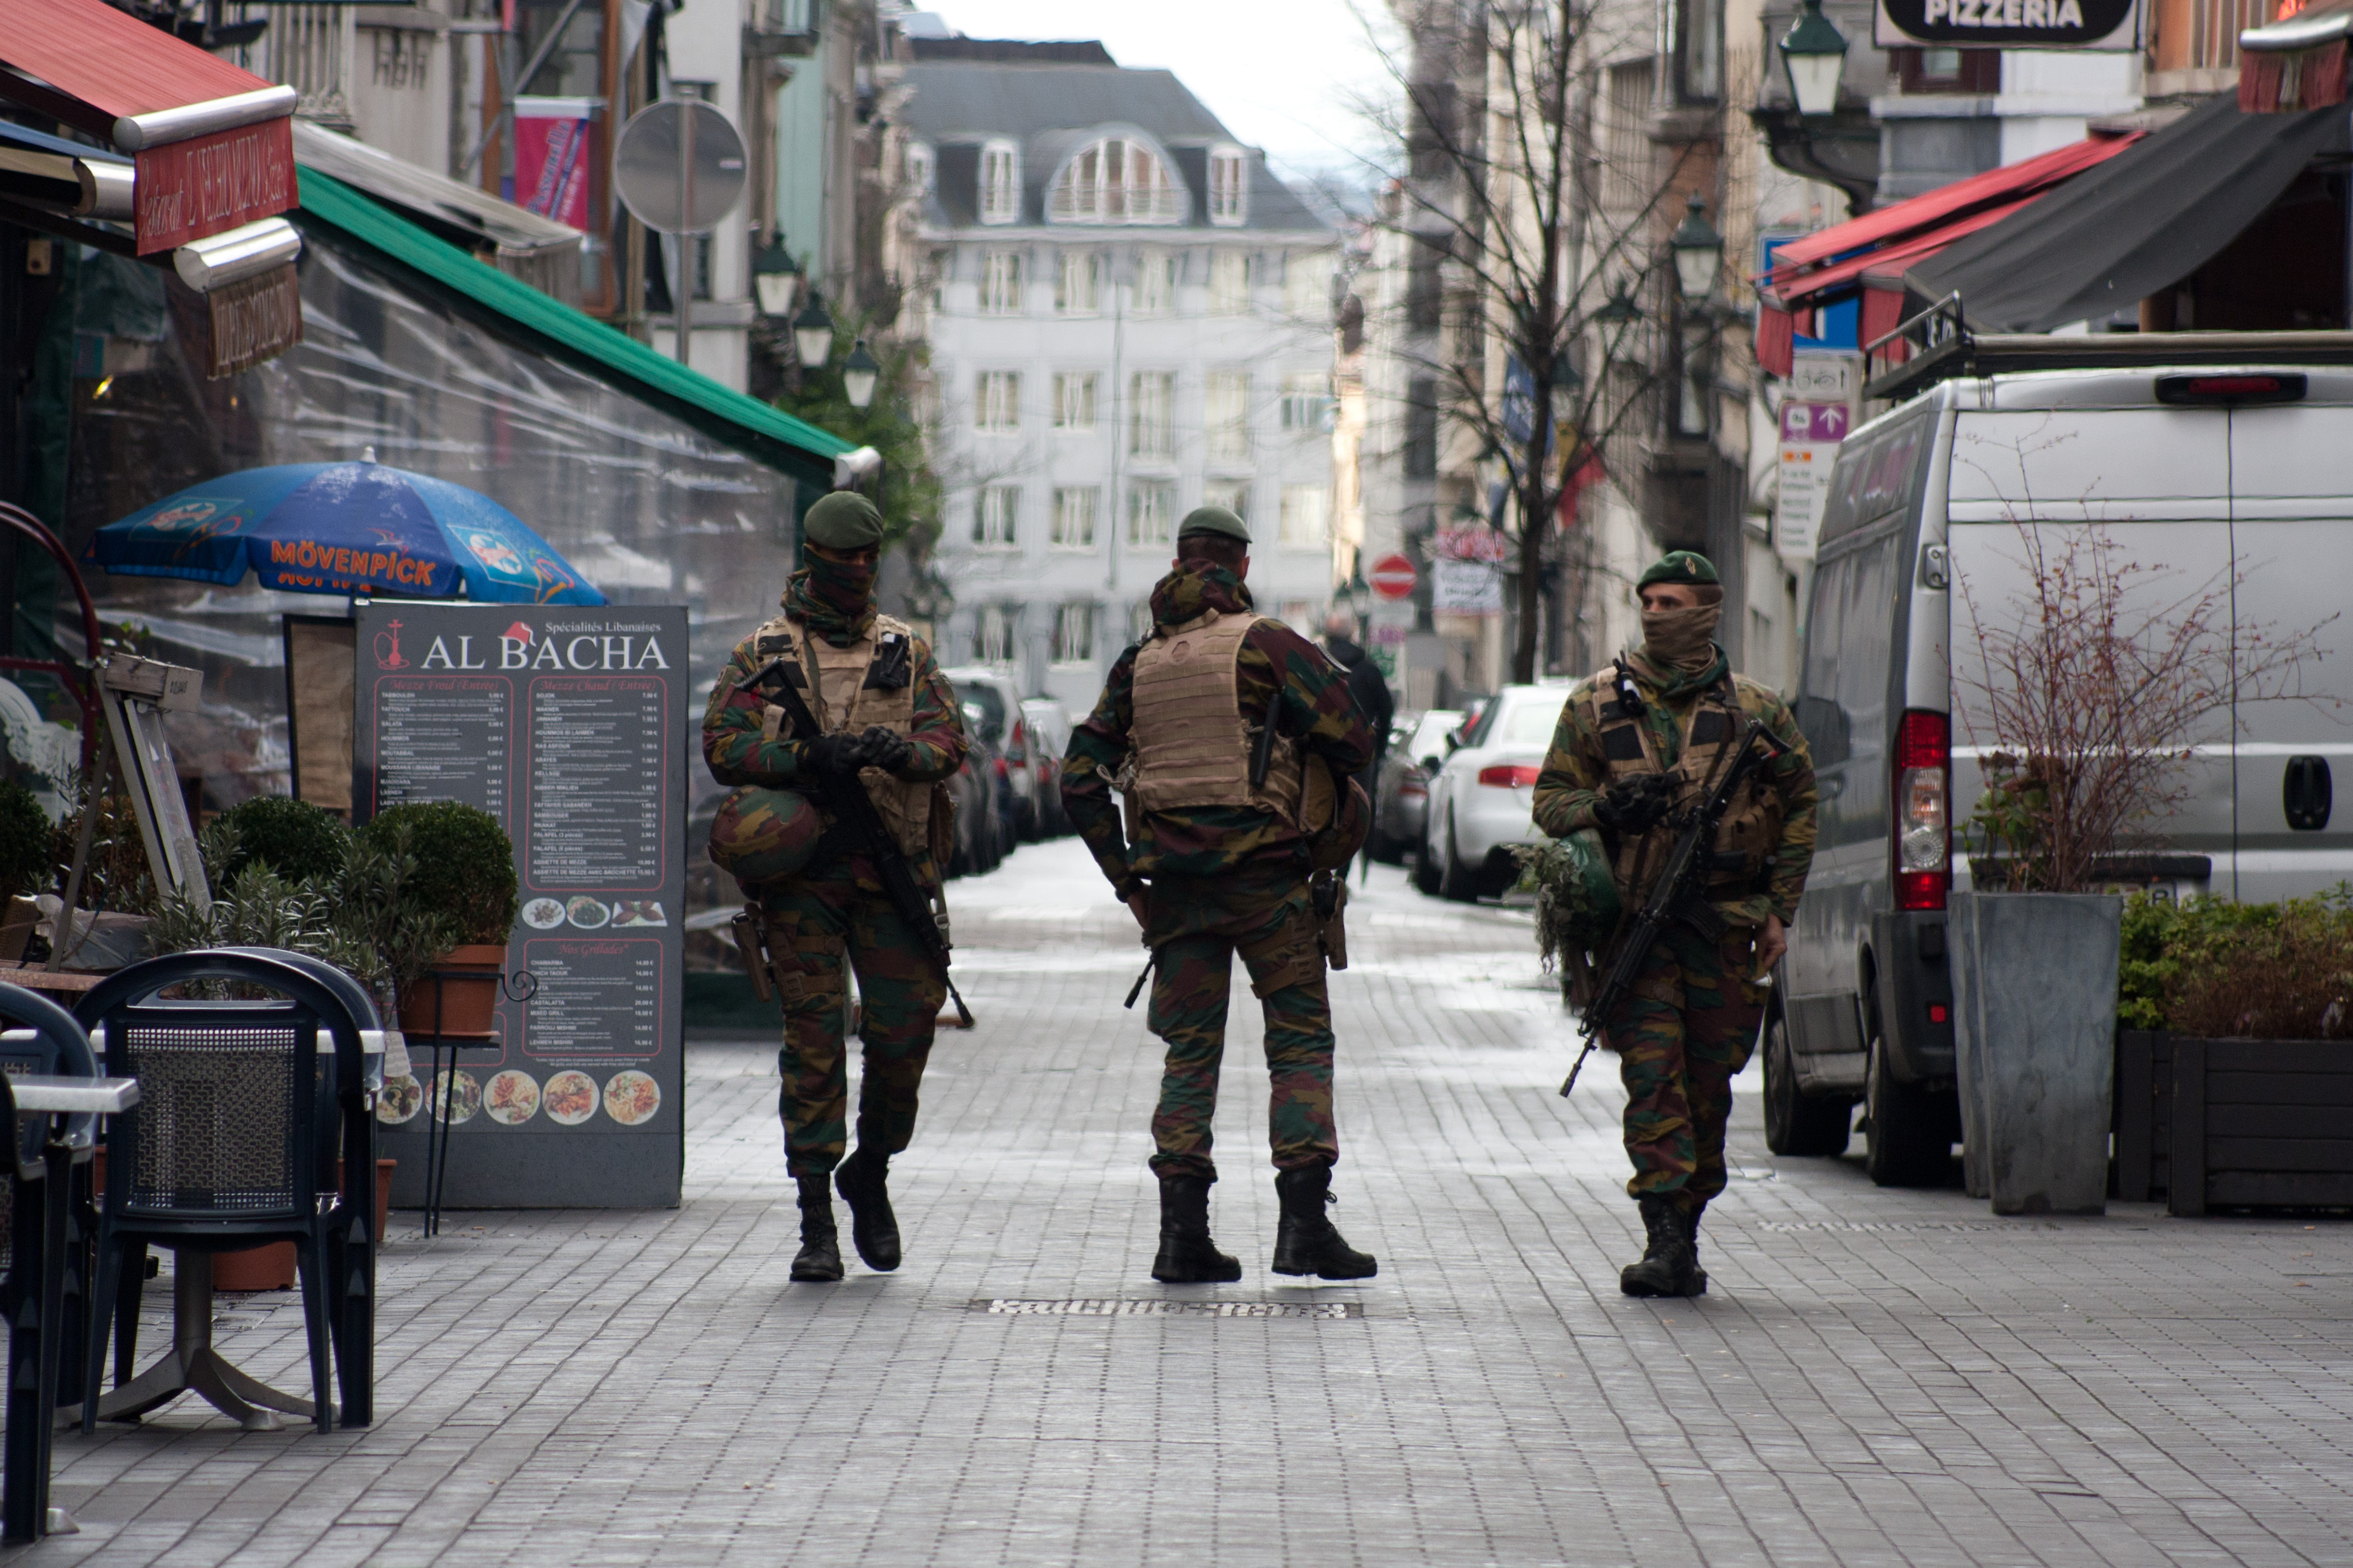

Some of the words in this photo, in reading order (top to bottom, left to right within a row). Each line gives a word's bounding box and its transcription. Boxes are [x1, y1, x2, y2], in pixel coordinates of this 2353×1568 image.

[1924, 0, 2083, 27] PIZZERIA
[271, 540, 436, 586] MÖVENPICK
[546, 622, 602, 633] Spécialités
[605, 622, 661, 632] Libanaises
[420, 636, 486, 670] AL
[497, 635, 670, 670] BACHA
